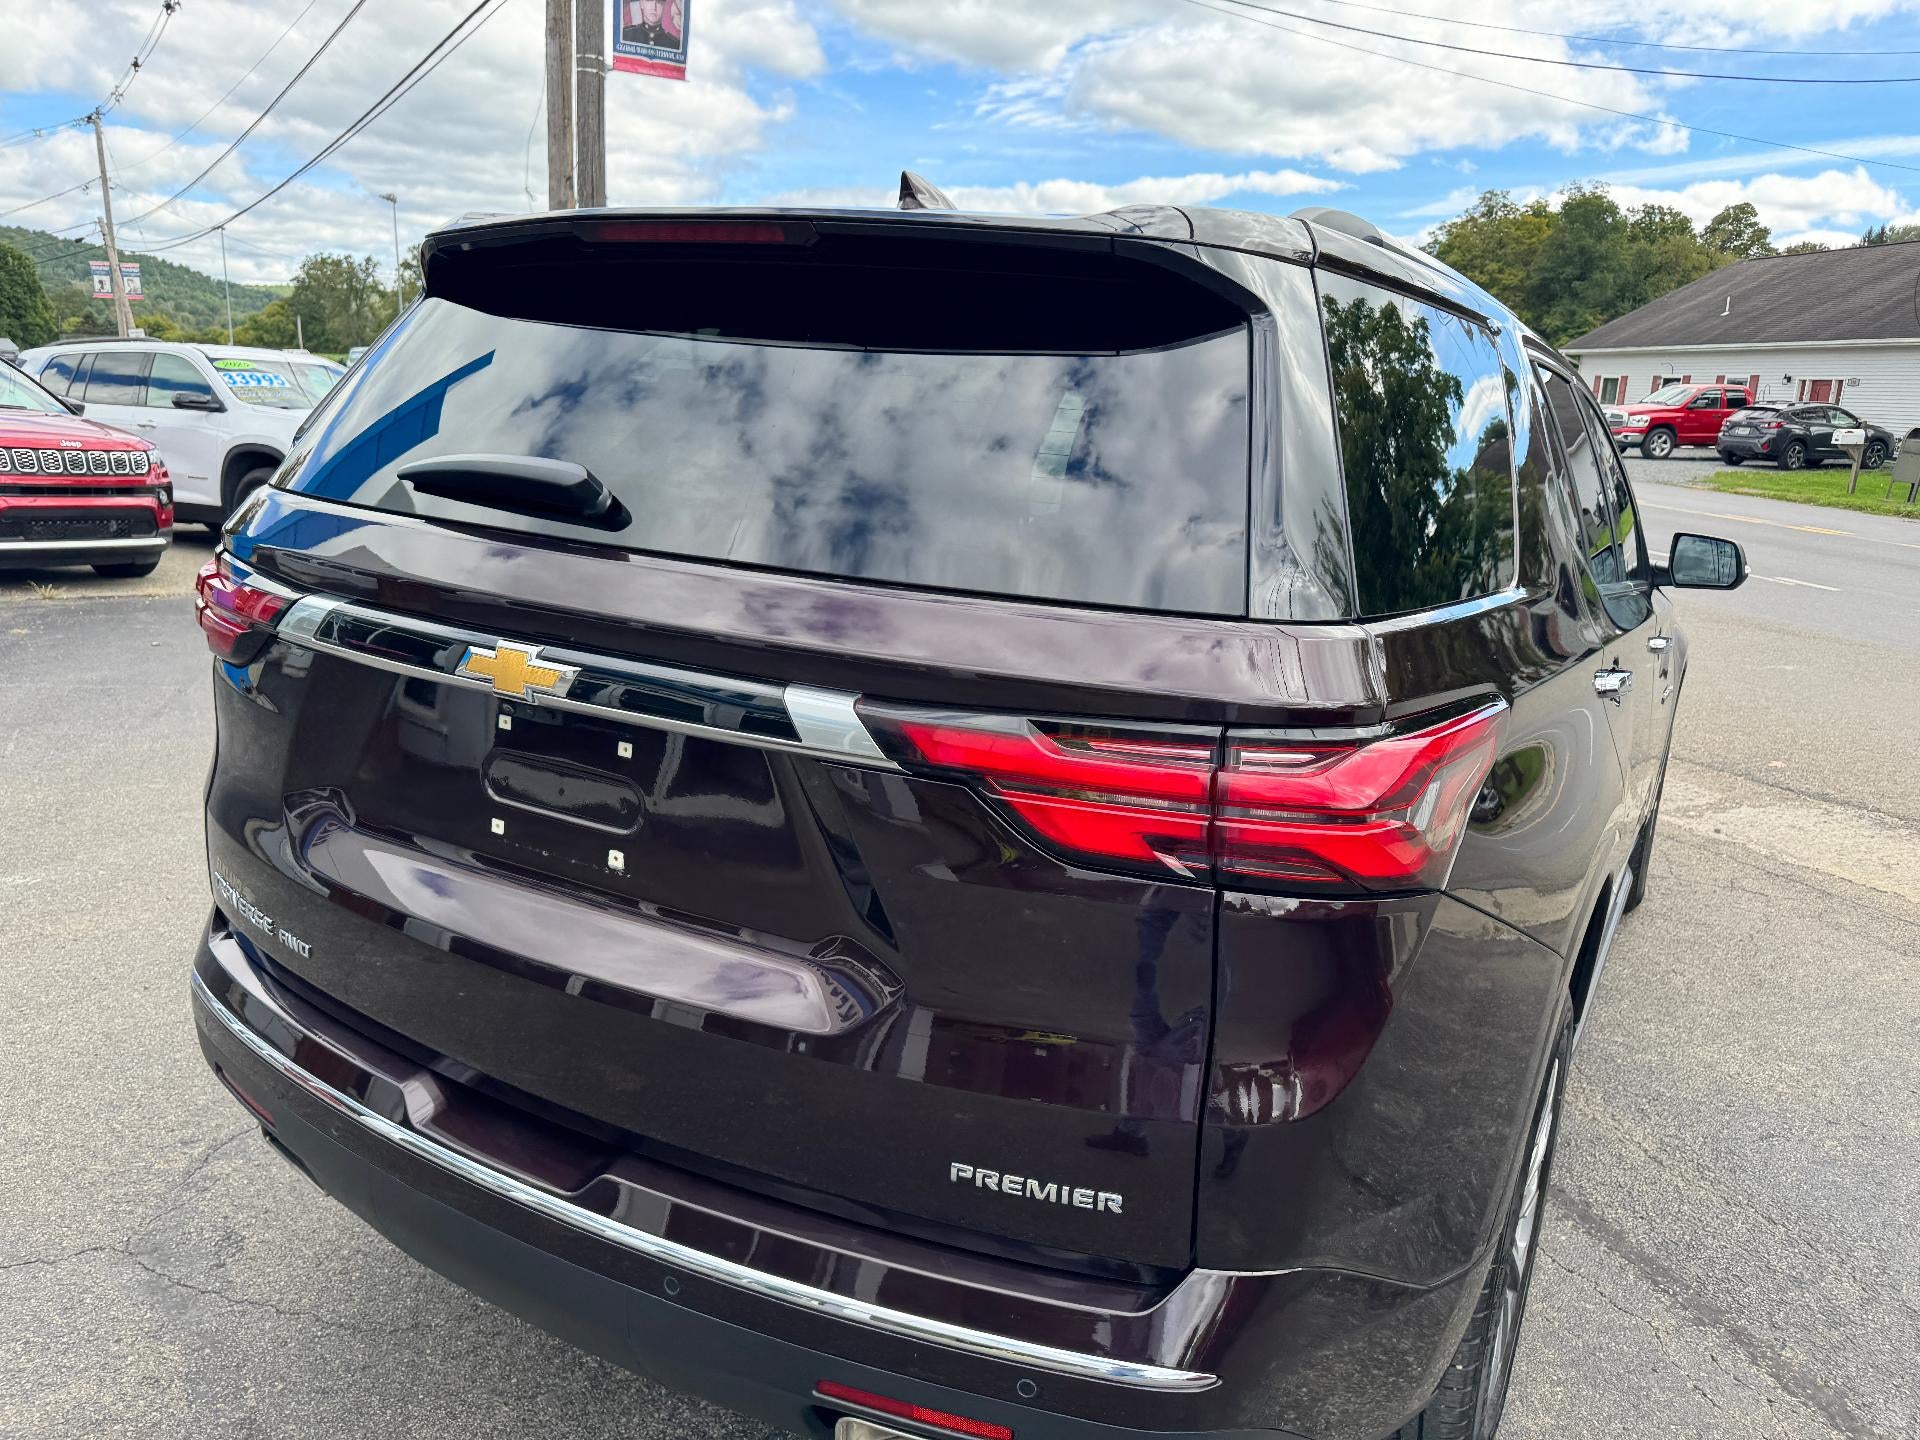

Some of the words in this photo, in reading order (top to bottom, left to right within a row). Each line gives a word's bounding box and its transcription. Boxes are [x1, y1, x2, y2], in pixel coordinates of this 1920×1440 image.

[223, 372, 286, 386] 33995
[60, 439, 83, 449] Jeep
[278, 928, 312, 959] AWD
[950, 1162, 1123, 1214] PREMIER
